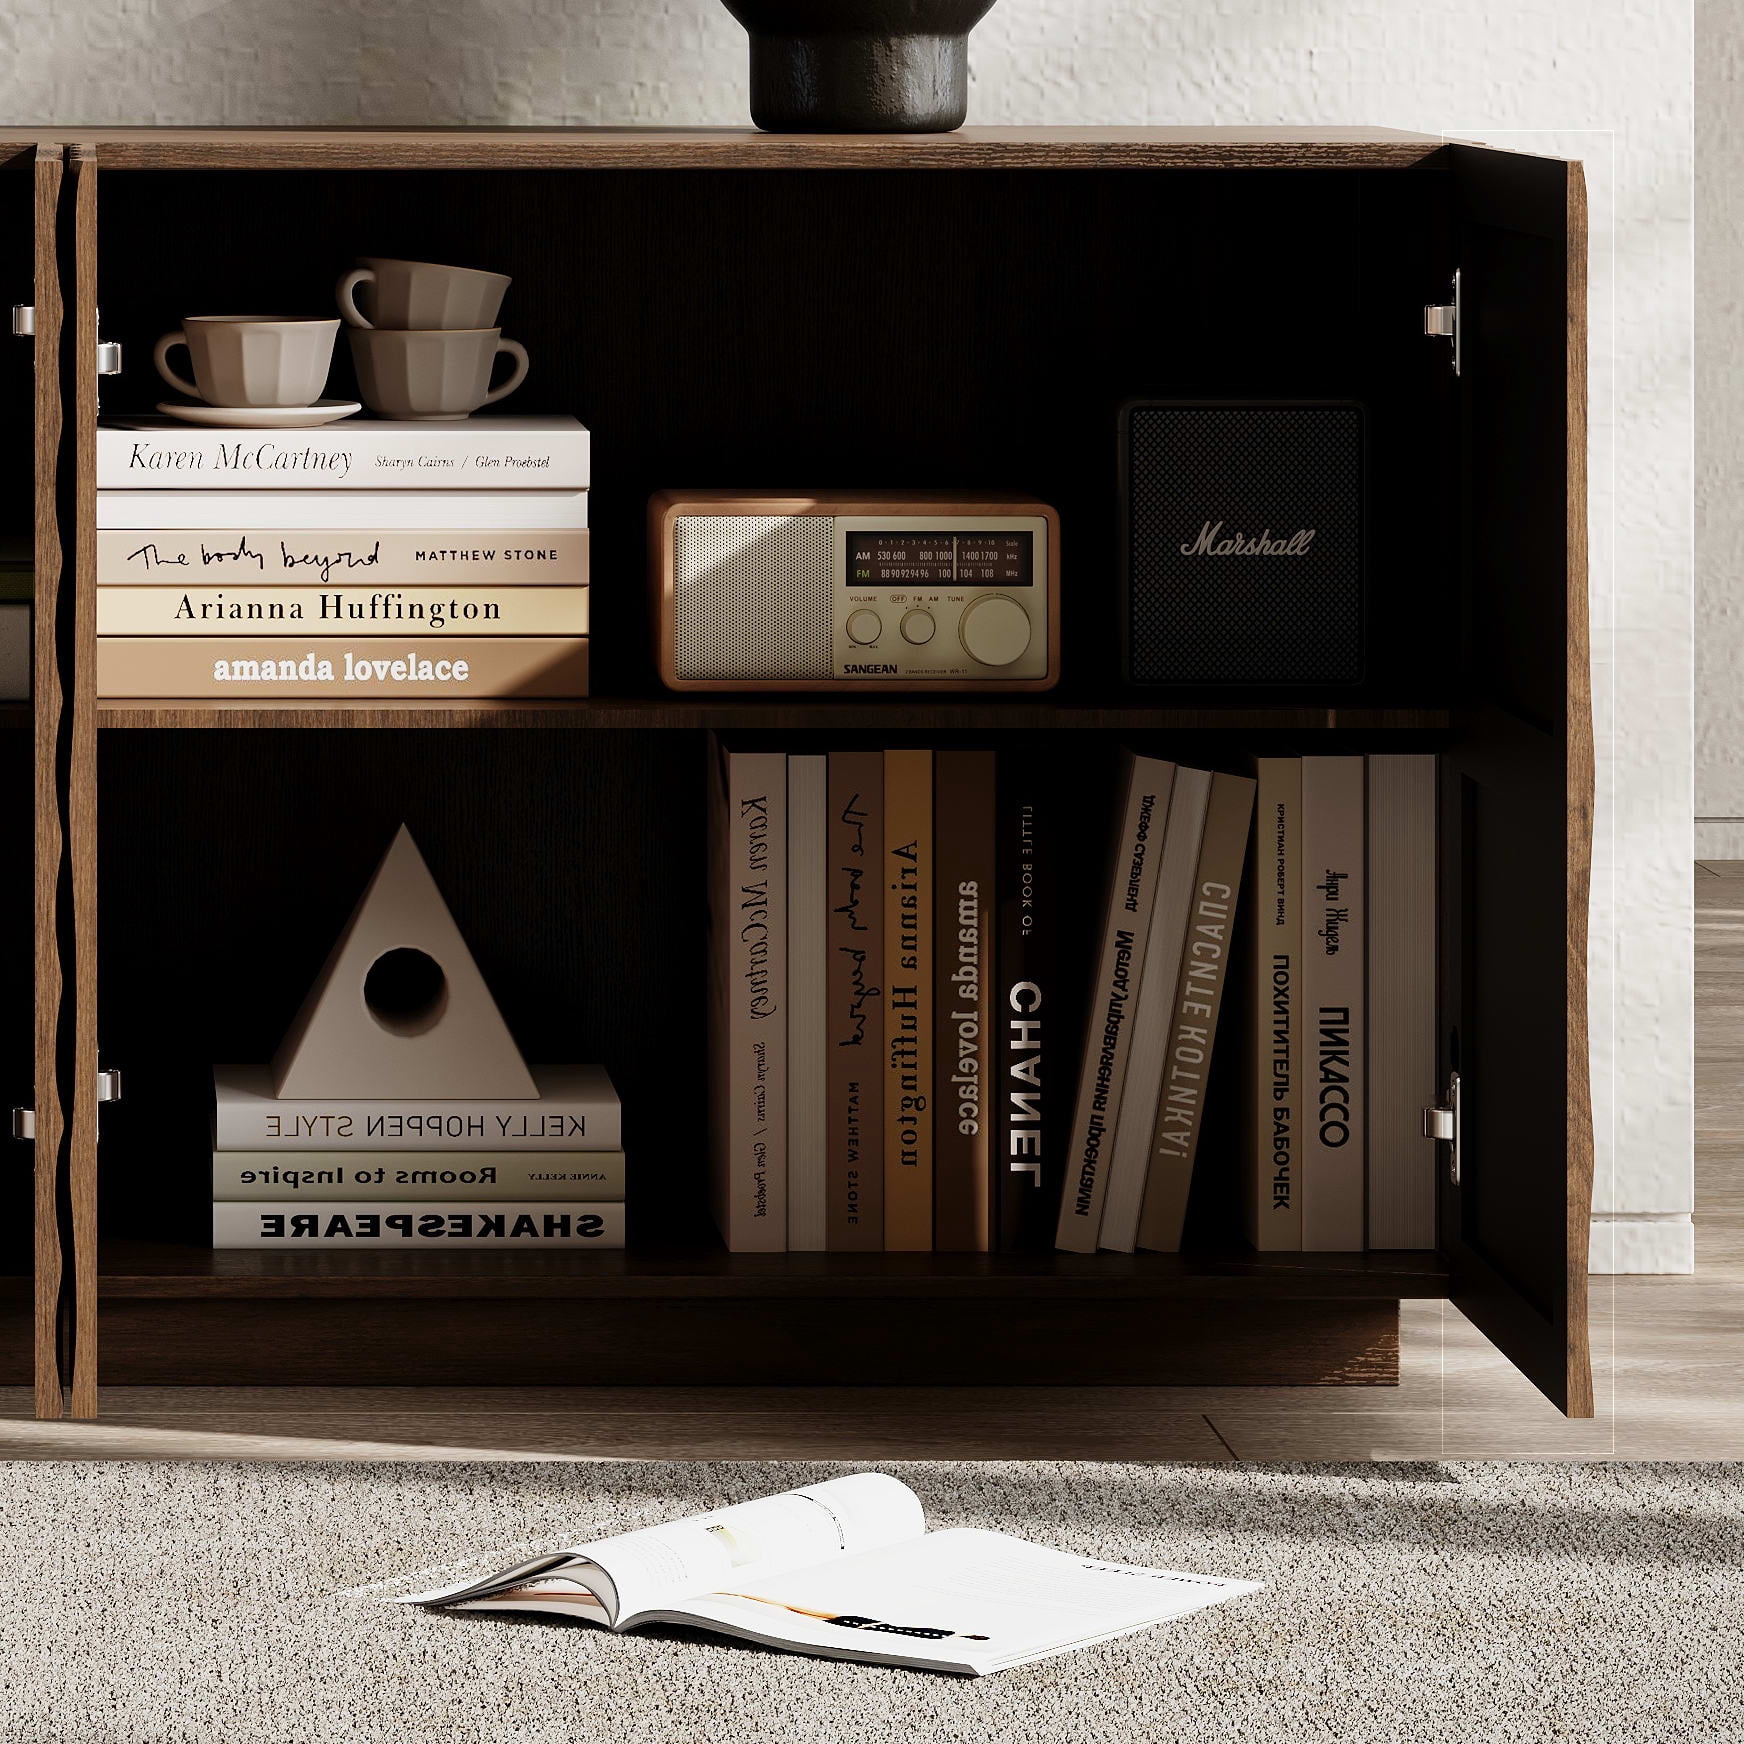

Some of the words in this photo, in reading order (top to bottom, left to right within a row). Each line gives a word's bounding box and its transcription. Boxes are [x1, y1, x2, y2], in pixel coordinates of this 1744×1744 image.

[129, 443, 205, 470] Karen
[214, 442, 352, 479] McCartney
[374, 455, 413, 472] Sharyn
[418, 455, 455, 468] Cairns
[475, 455, 501, 468] Glen
[504, 455, 550, 468] Proebstel
[1180, 521, 1316, 555] Marshall
[127, 543, 190, 571] The
[200, 536, 264, 570] body
[281, 541, 381, 583] beyond
[415, 550, 496, 561] MATTHEW
[504, 550, 558, 561] STONE
[855, 552, 871, 561] AM
[877, 551, 891, 561] 530
[892, 551, 906, 561] 600
[936, 551, 952, 561] 1000
[962, 551, 979, 561] 1400
[980, 551, 998, 561] 1700
[856, 569, 870, 578] FM
[881, 569, 890, 578] 88
[891, 569, 900, 578] 90
[938, 569, 951, 578] 100
[960, 569, 972, 578] 104
[981, 569, 994, 578] 108
[173, 593, 304, 620] Arianna
[319, 593, 501, 628] Huffington
[213, 653, 335, 681] amanda
[343, 653, 469, 681] lovelace
[844, 664, 898, 674] SANGEAN
[1276, 803, 1285, 856] КРИСТИАН
[1276, 858, 1285, 896] РОБЕРТ
[1276, 898, 1285, 925] ВИНД
[1273, 955, 1291, 1101] ПОХИТИТЕЛЬ
[1318, 1007, 1350, 1148] ПИКАССО
[1273, 1106, 1291, 1210] БАБОЧЕК
